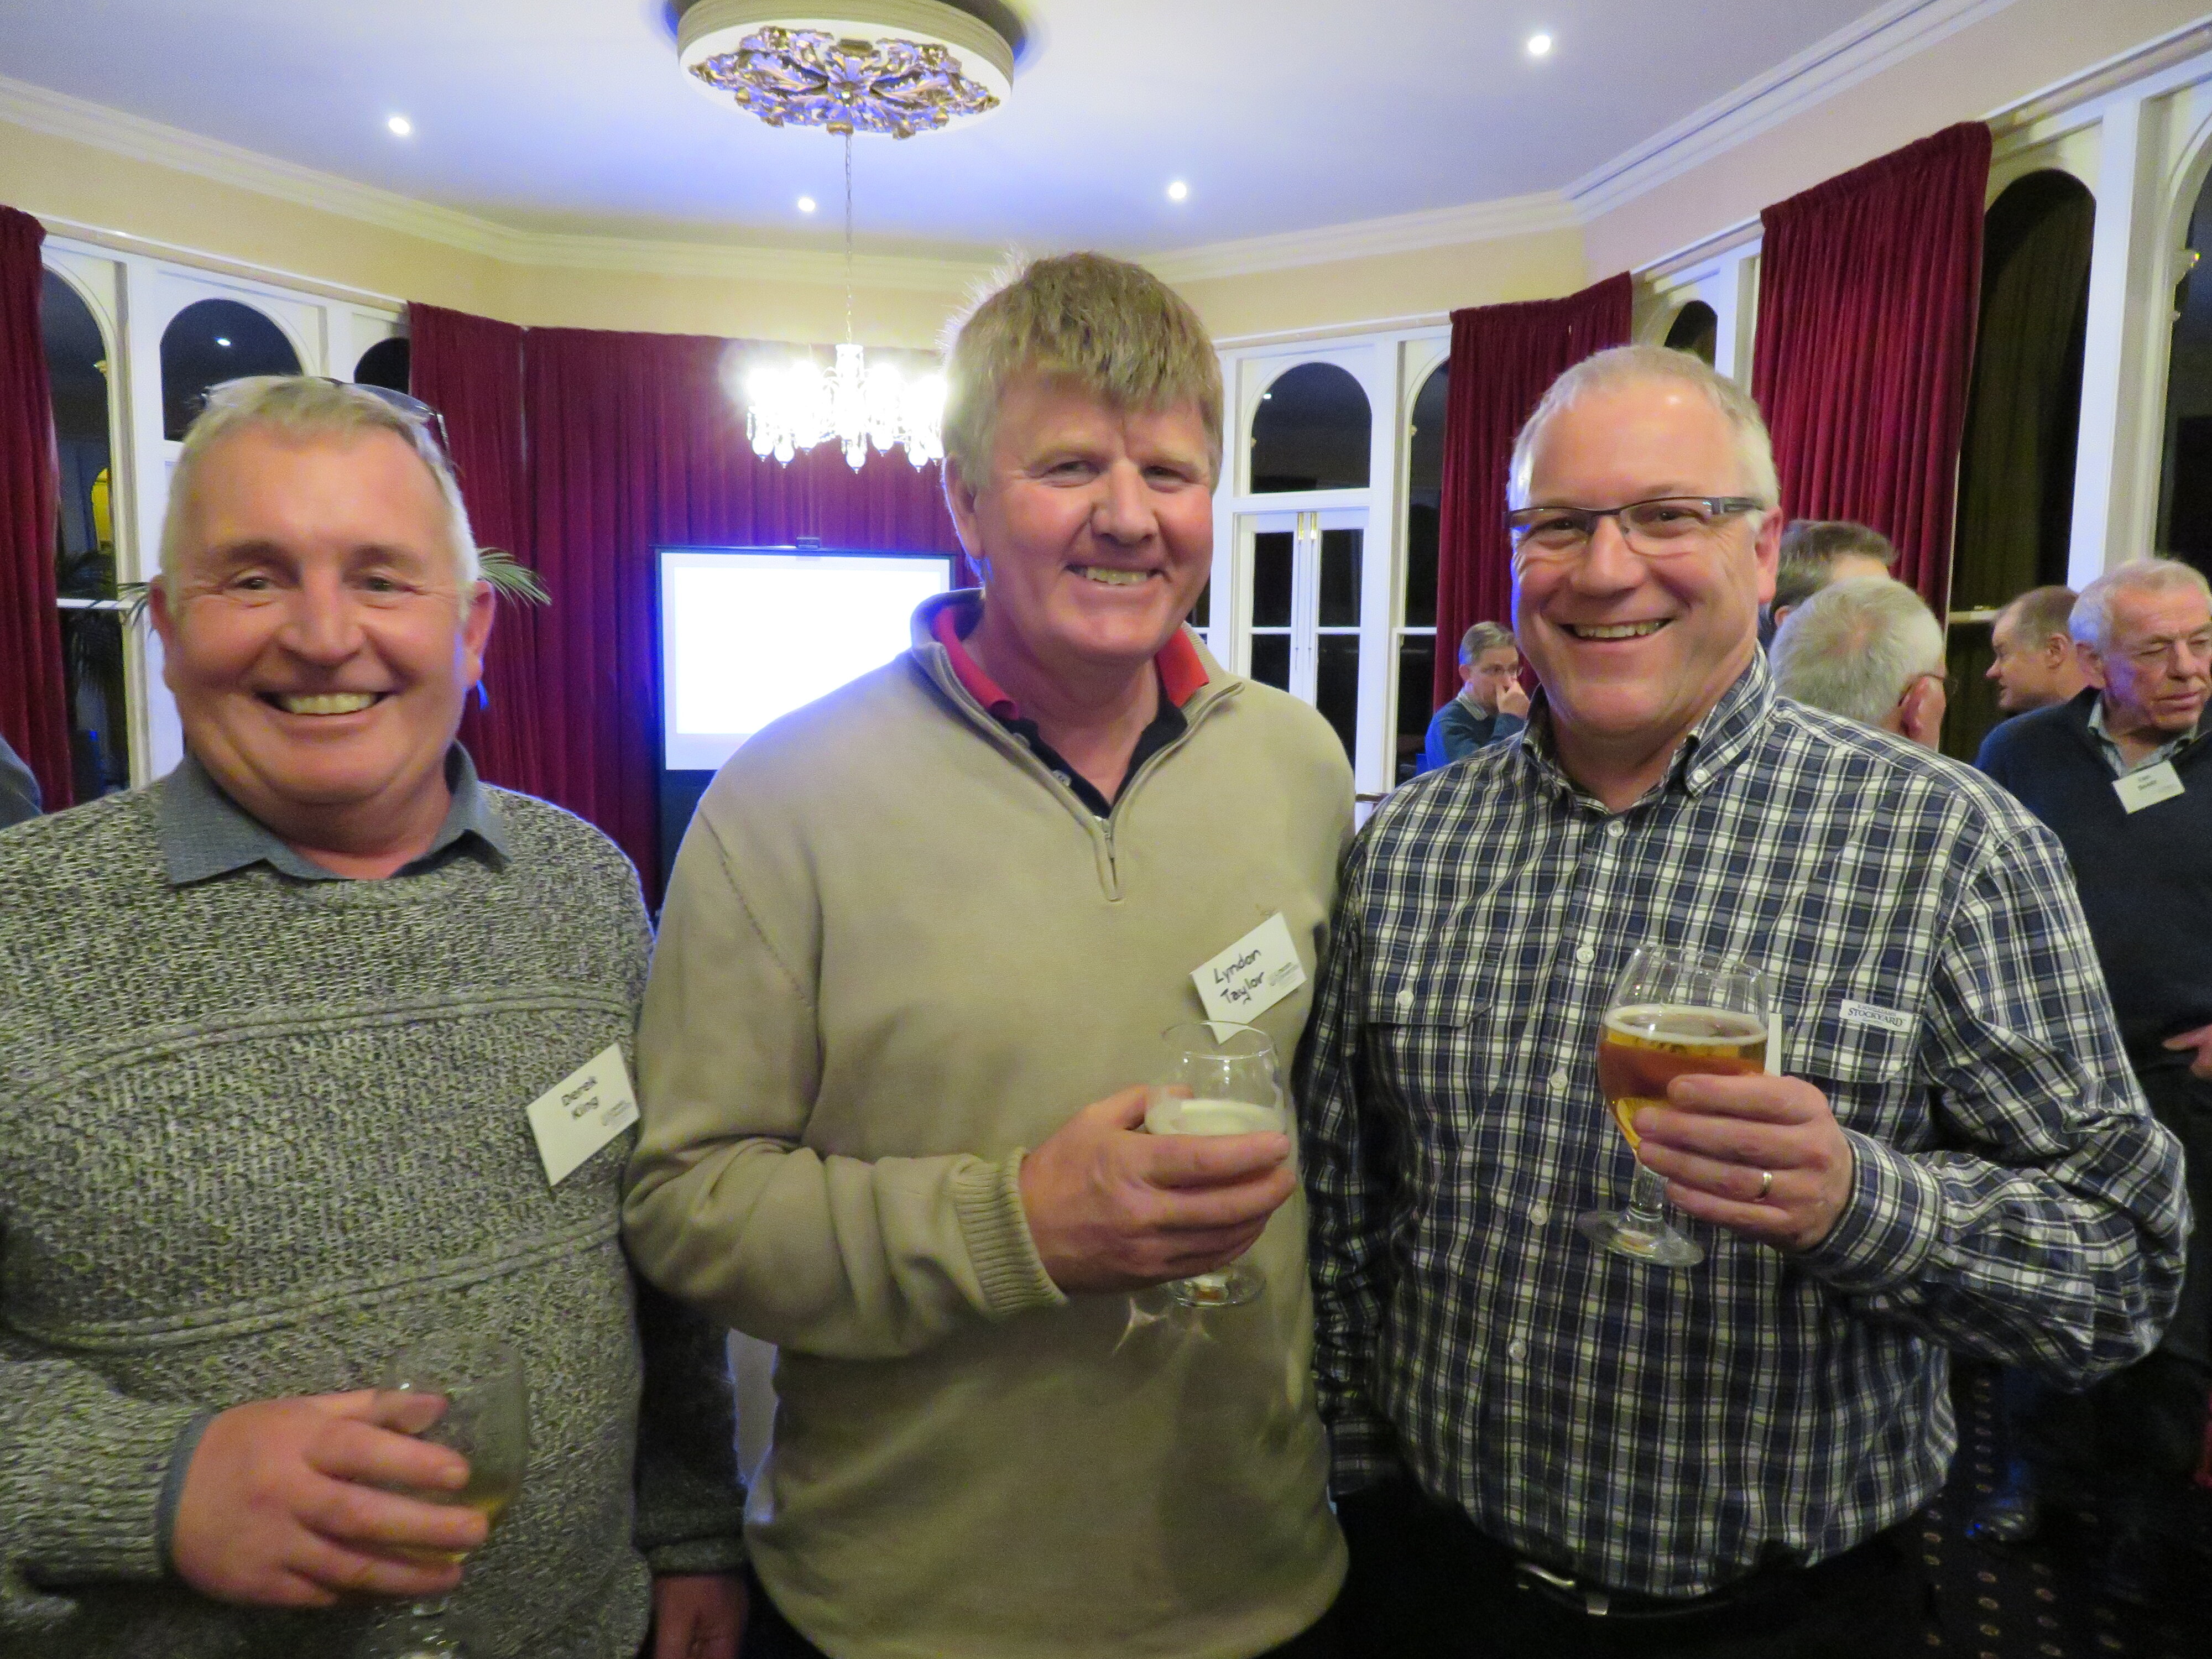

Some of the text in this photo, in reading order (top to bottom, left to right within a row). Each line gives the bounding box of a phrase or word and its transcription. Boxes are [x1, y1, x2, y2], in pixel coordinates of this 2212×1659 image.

[1213, 949, 1261, 984] Lyndon
[1219, 971, 1265, 1005] Taylor
[1848, 1007, 1903, 1027] STOCKYARD
